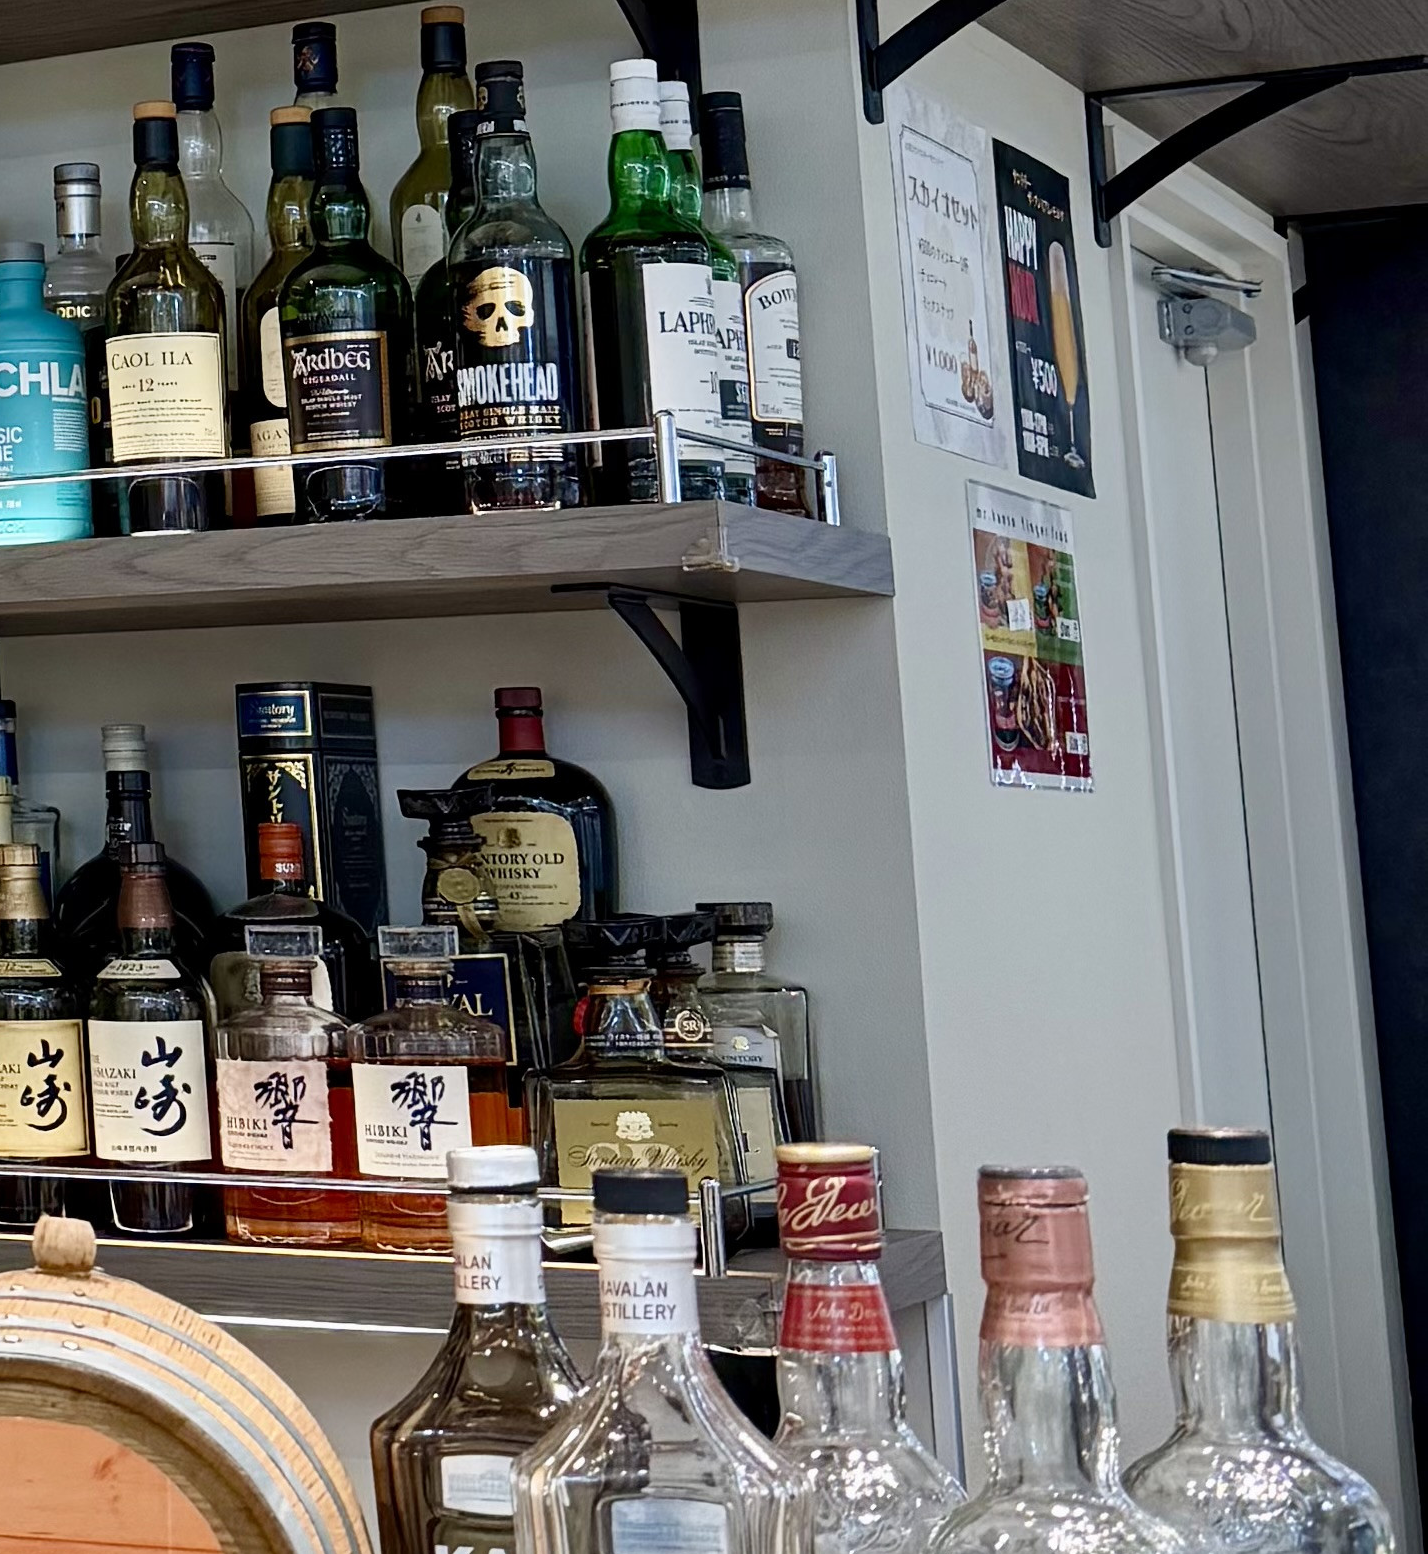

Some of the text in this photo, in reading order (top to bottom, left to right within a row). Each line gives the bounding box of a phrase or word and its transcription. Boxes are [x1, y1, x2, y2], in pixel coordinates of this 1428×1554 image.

[908, 175, 978, 230] スカイオセット
[111, 349, 193, 370] CAOL ILA
[138, 377, 155, 392] 12
[456, 362, 559, 406] SMOKEHEAD
[1030, 357, 1058, 398] ¥500
[501, 414, 561, 428] WHISKY
[528, 404, 561, 417] MALT
[532, 852, 565, 865] OLD
[20, 1038, 72, 1132] 山崎
[134, 1035, 192, 1137] 山崎
[227, 1116, 268, 1131] HIBIKI
[254, 1071, 319, 1150] 響
[391, 1071, 458, 1151] 響
[364, 1124, 408, 1138] HIBIKI
[568, 1144, 708, 1174] Suntory Whisky
